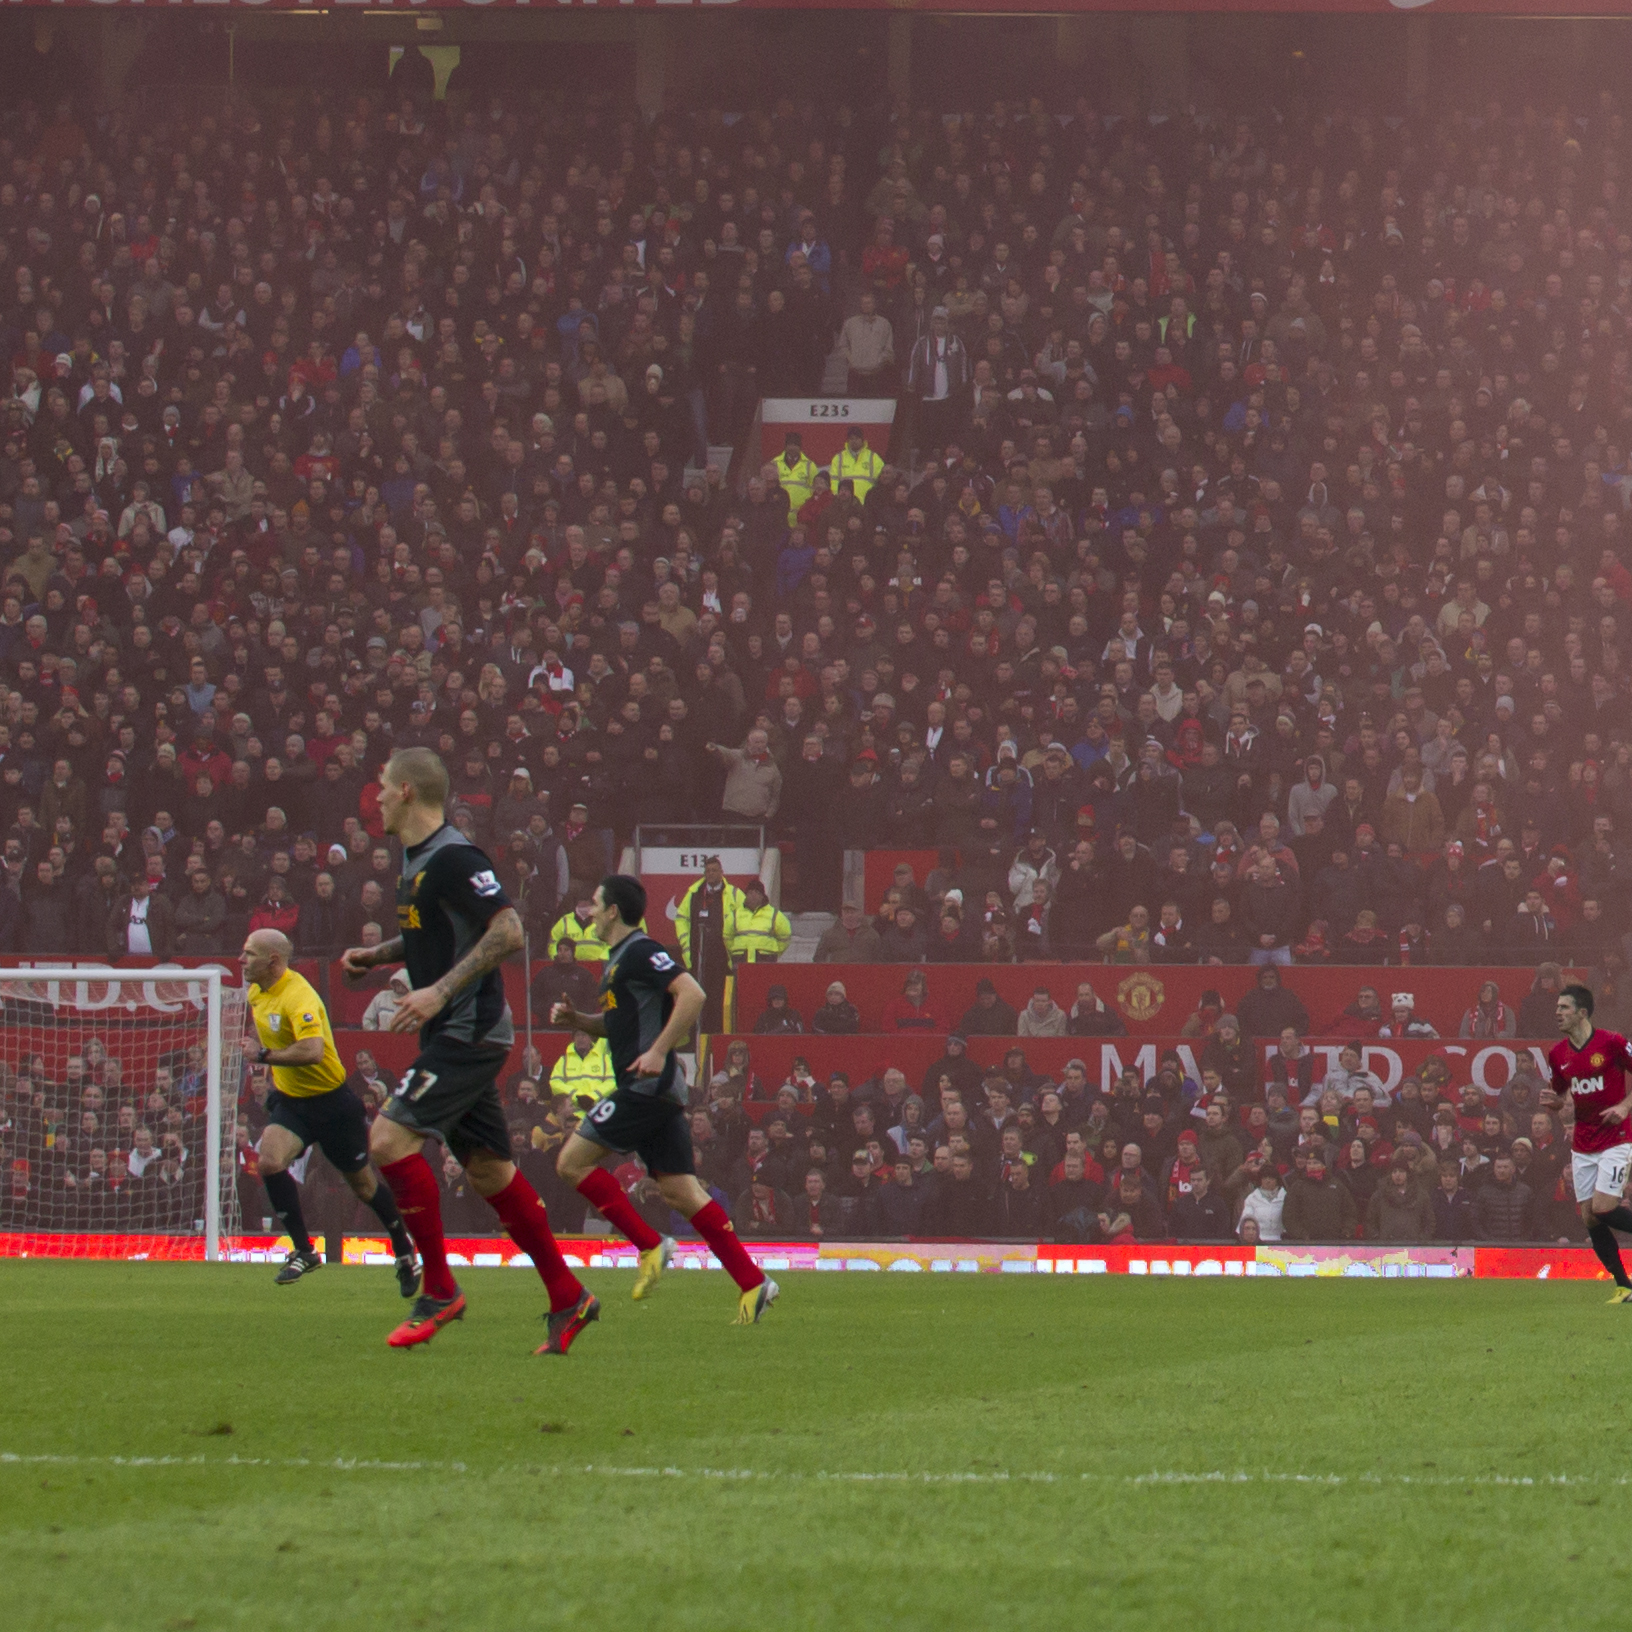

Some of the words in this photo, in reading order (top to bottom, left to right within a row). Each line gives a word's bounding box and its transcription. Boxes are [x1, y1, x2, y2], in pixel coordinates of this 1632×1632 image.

[809, 404, 850, 417] E235
[394, 1068, 438, 1102] 37
[1570, 1075, 1604, 1095] AON
